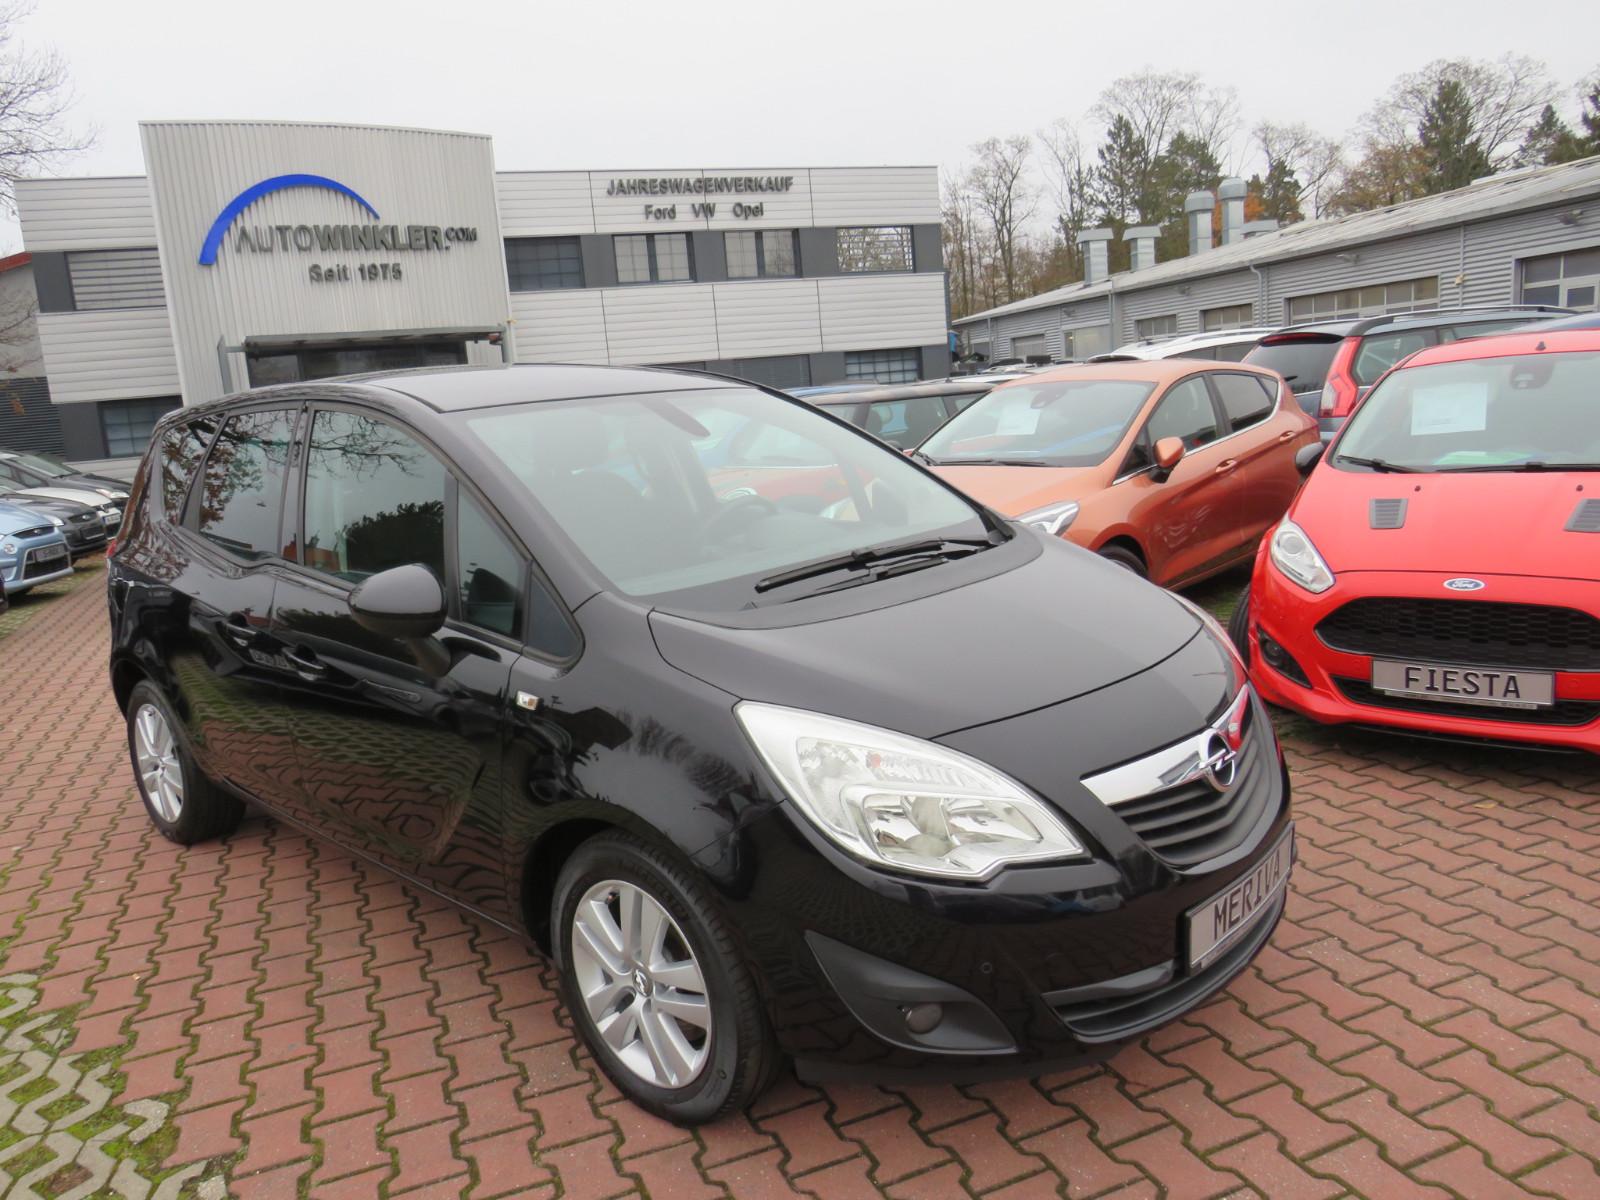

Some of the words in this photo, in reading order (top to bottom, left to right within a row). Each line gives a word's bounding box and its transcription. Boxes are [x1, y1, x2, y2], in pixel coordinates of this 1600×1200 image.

[606, 176, 794, 196] JAHRESWAGENVERKAUF
[644, 203, 677, 220] Ford
[691, 202, 717, 219] VW
[732, 201, 764, 220] Opel
[308, 263, 350, 283] Seit
[357, 262, 403, 282] 1975
[1404, 666, 1521, 699] FIESTA
[1213, 849, 1281, 941] MERIVA
